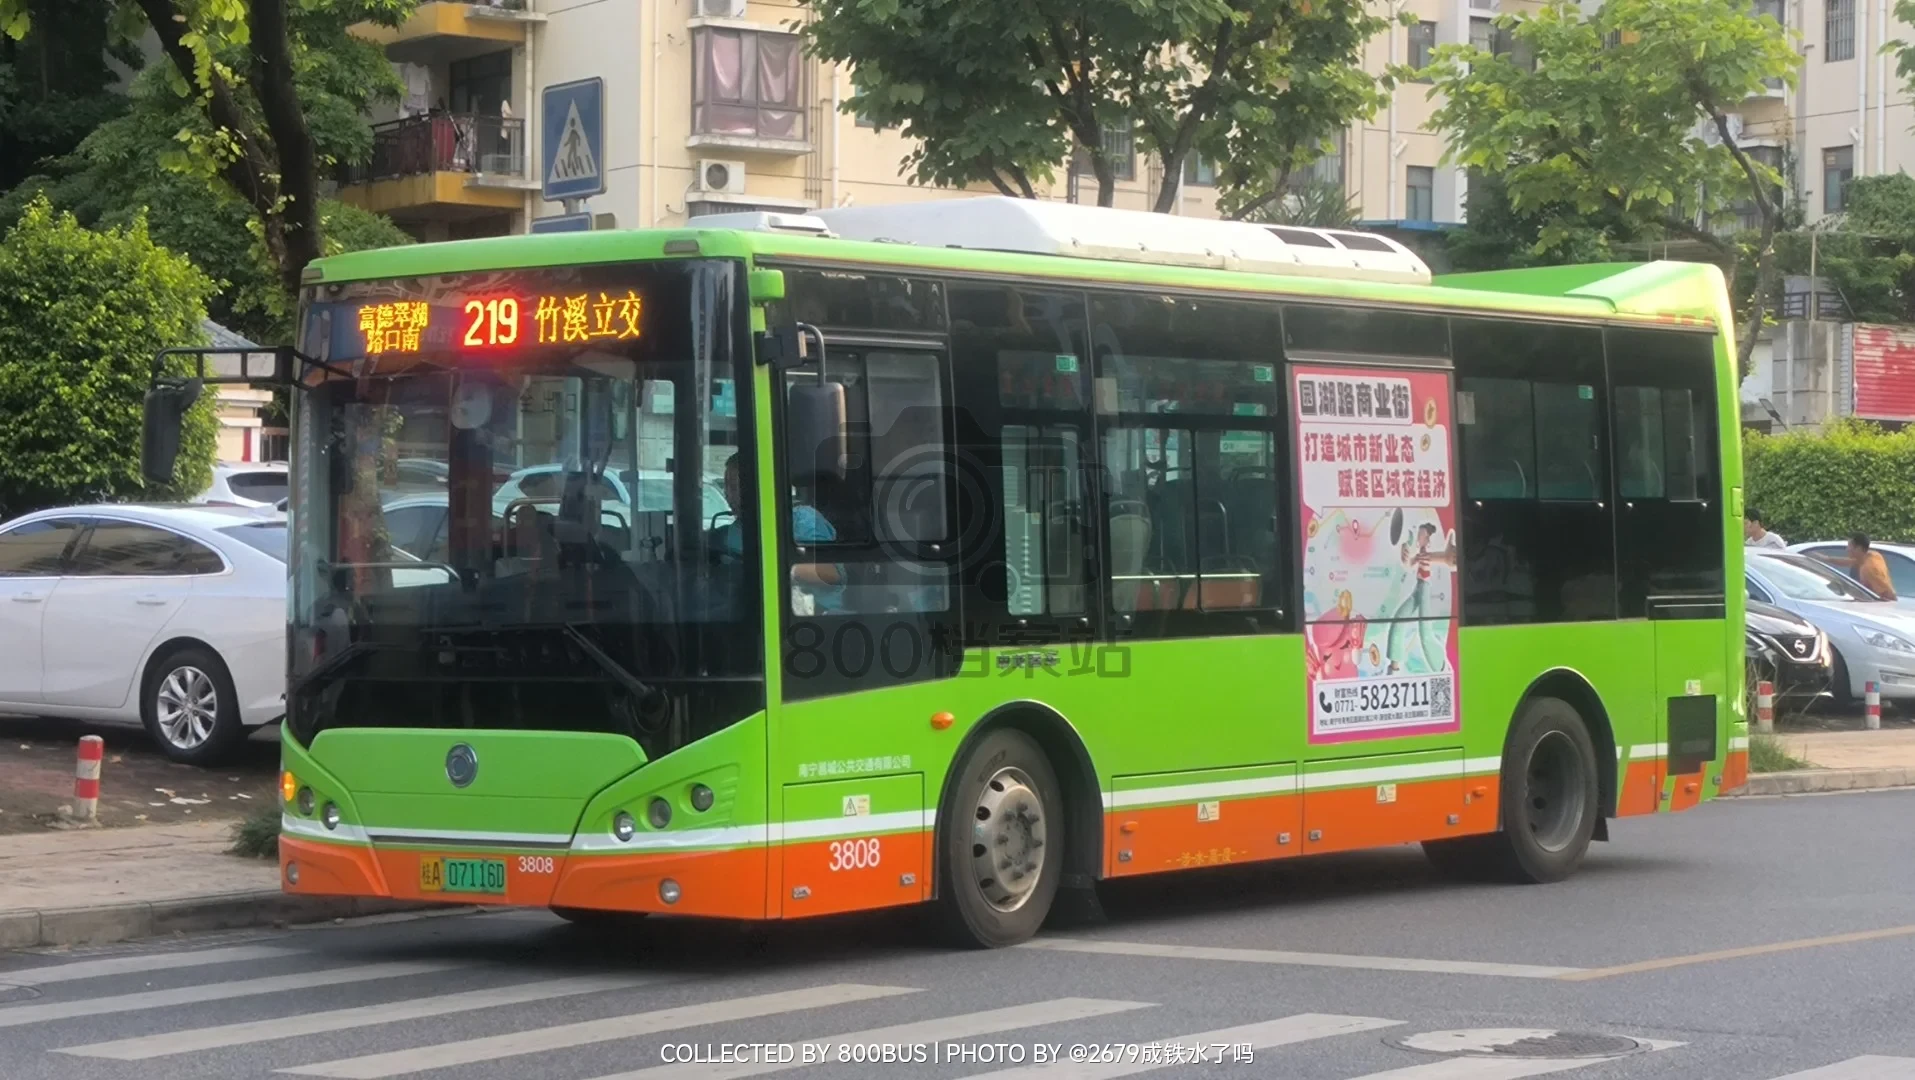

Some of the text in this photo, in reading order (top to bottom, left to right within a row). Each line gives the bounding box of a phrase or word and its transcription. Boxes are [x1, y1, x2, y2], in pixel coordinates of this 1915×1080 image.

[463, 299, 518, 345] 219
[535, 290, 641, 343] 竹溪立交
[1304, 432, 1415, 464] 打造城市新业态
[1337, 468, 1446, 499] 赋能区域夜经济
[518, 856, 554, 873] 3808
[829, 838, 881, 871] 3808
[448, 862, 505, 888] 07116D
